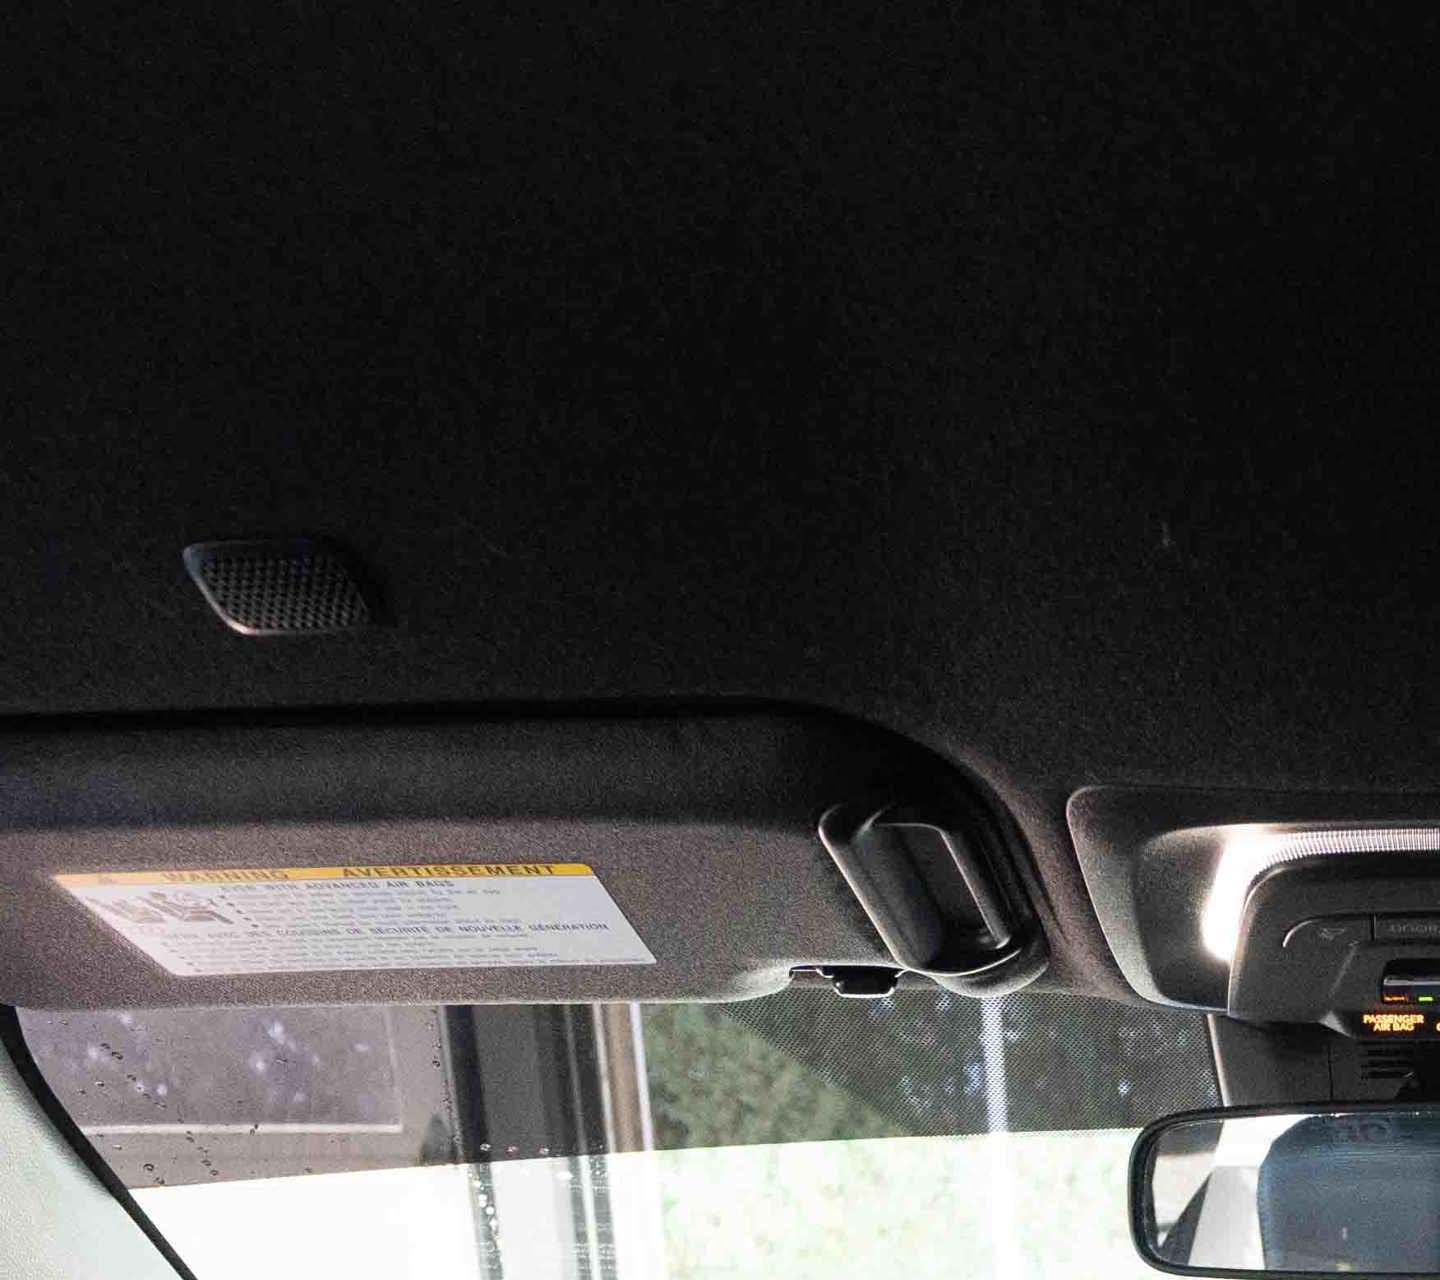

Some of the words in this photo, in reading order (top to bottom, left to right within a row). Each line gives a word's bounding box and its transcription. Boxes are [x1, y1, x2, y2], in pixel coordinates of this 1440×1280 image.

[162, 868, 289, 882] WARNING
[342, 864, 557, 878] AVERTISSEMENT
[1363, 1014, 1425, 1024] PASSENGER
[1373, 1023, 1392, 1032] AIR
[1393, 1023, 1415, 1032] BAG
